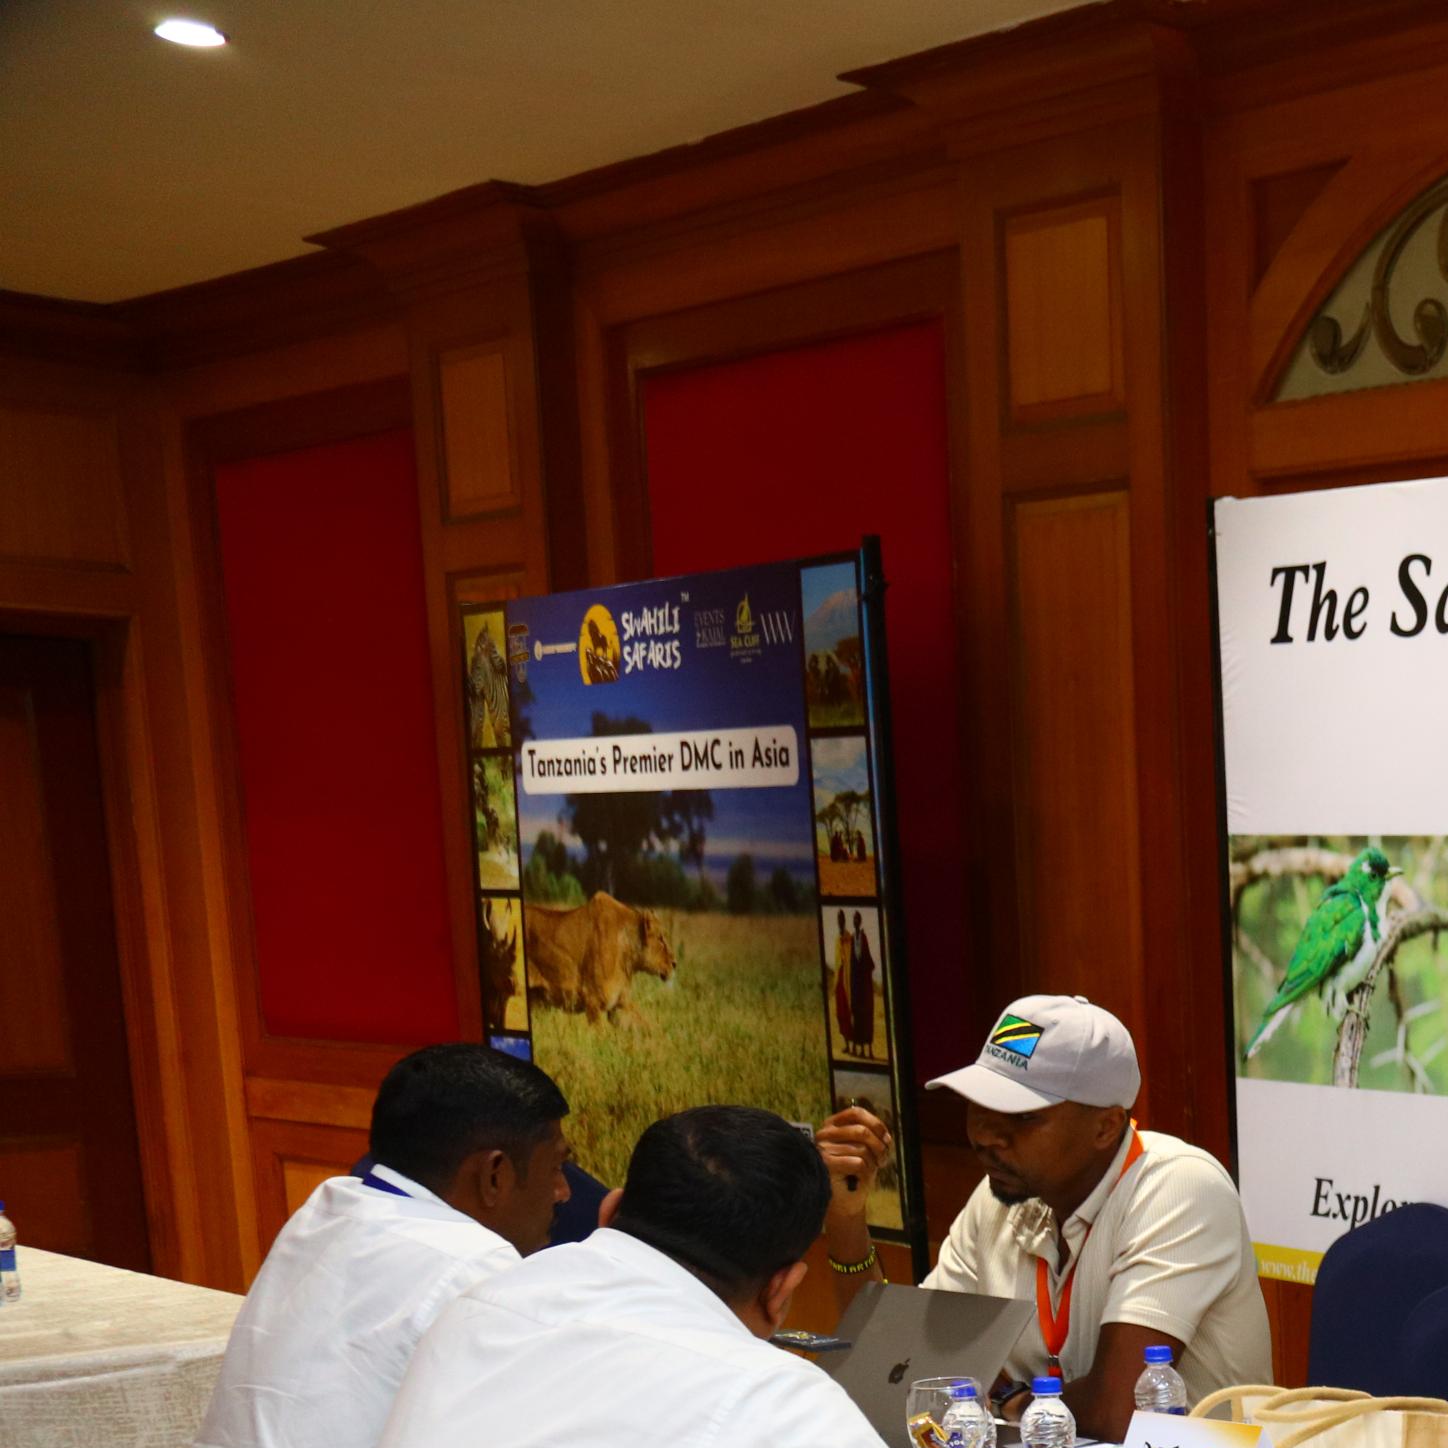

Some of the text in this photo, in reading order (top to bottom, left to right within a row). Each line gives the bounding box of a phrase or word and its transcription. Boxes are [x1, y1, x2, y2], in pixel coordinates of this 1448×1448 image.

[621, 601, 680, 641] SWAHILI
[1269, 560, 1369, 645] The
[623, 639, 682, 674] SAFARIS
[528, 736, 790, 778] Tanzania's Premier DMC in Asia
